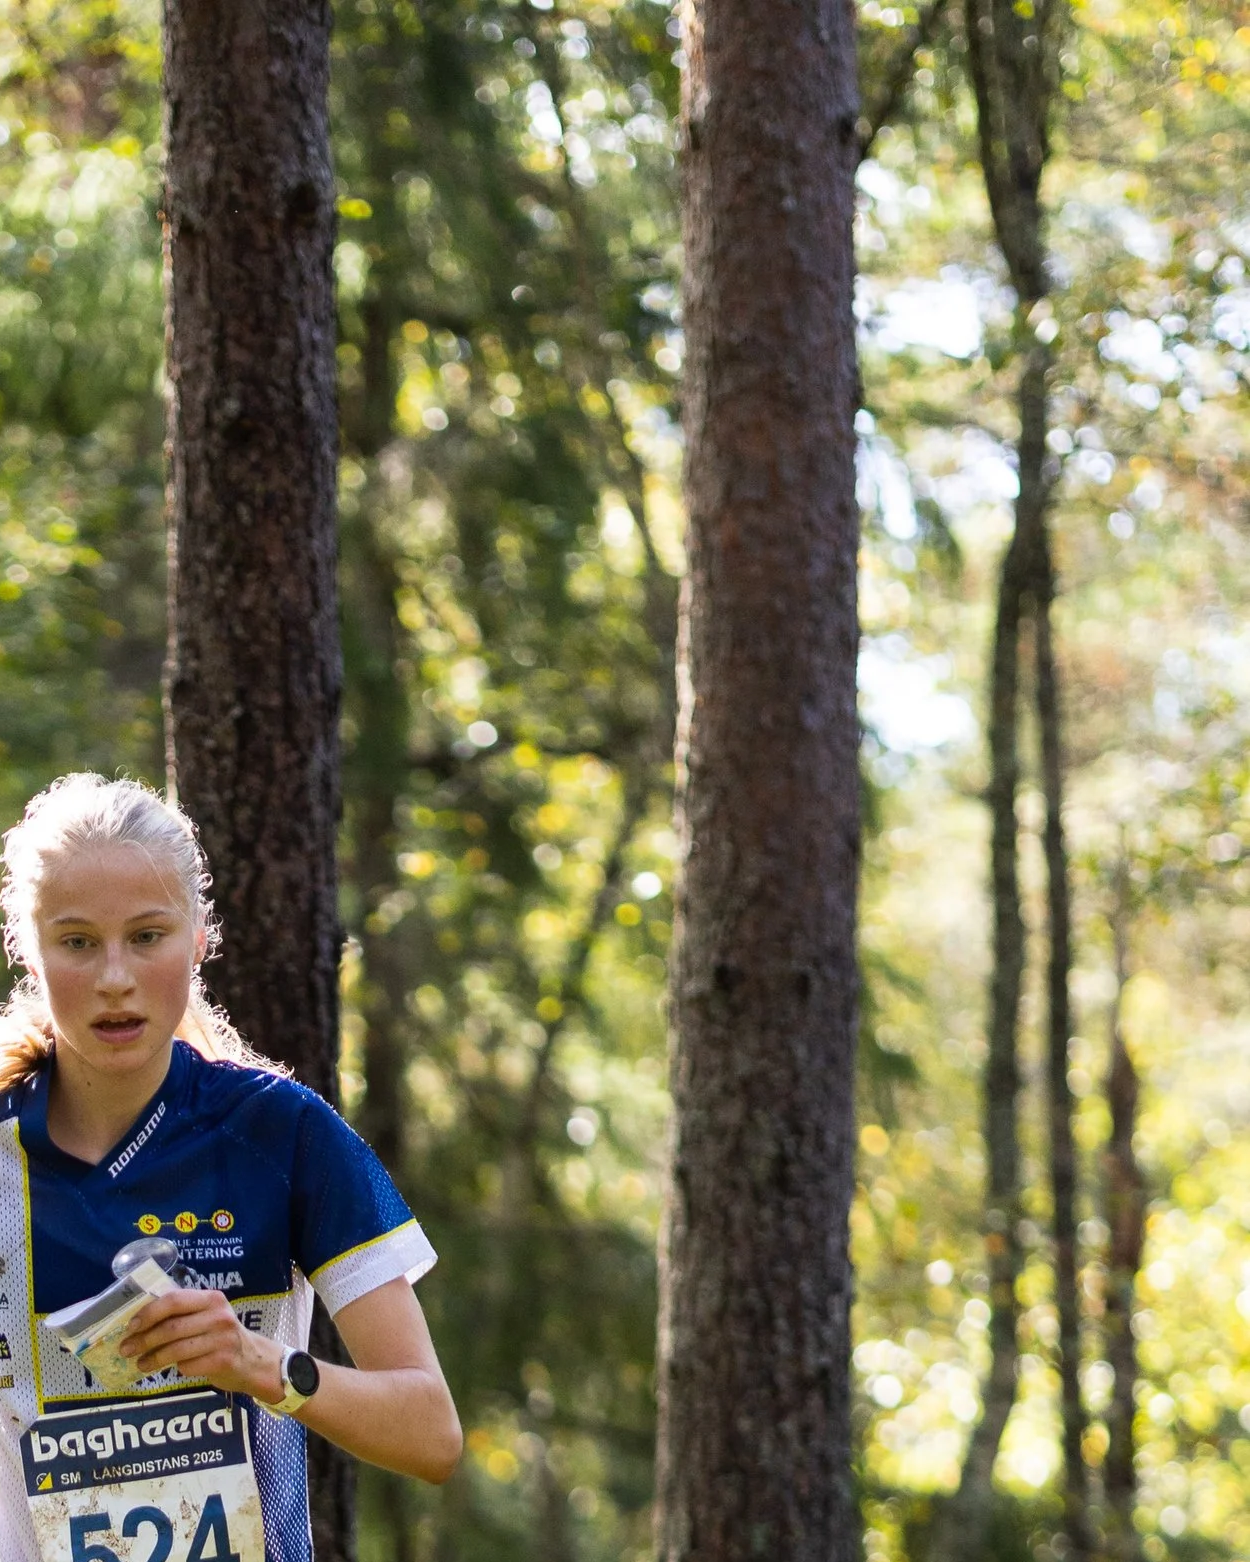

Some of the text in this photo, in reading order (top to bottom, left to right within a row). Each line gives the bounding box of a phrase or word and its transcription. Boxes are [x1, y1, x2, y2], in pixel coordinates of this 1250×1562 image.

[108, 1101, 166, 1178] noname
[197, 1236, 243, 1246] NYKVARN
[30, 1408, 234, 1462] bagheera
[60, 1472, 81, 1485] SM
[193, 1449, 224, 1465] 2025
